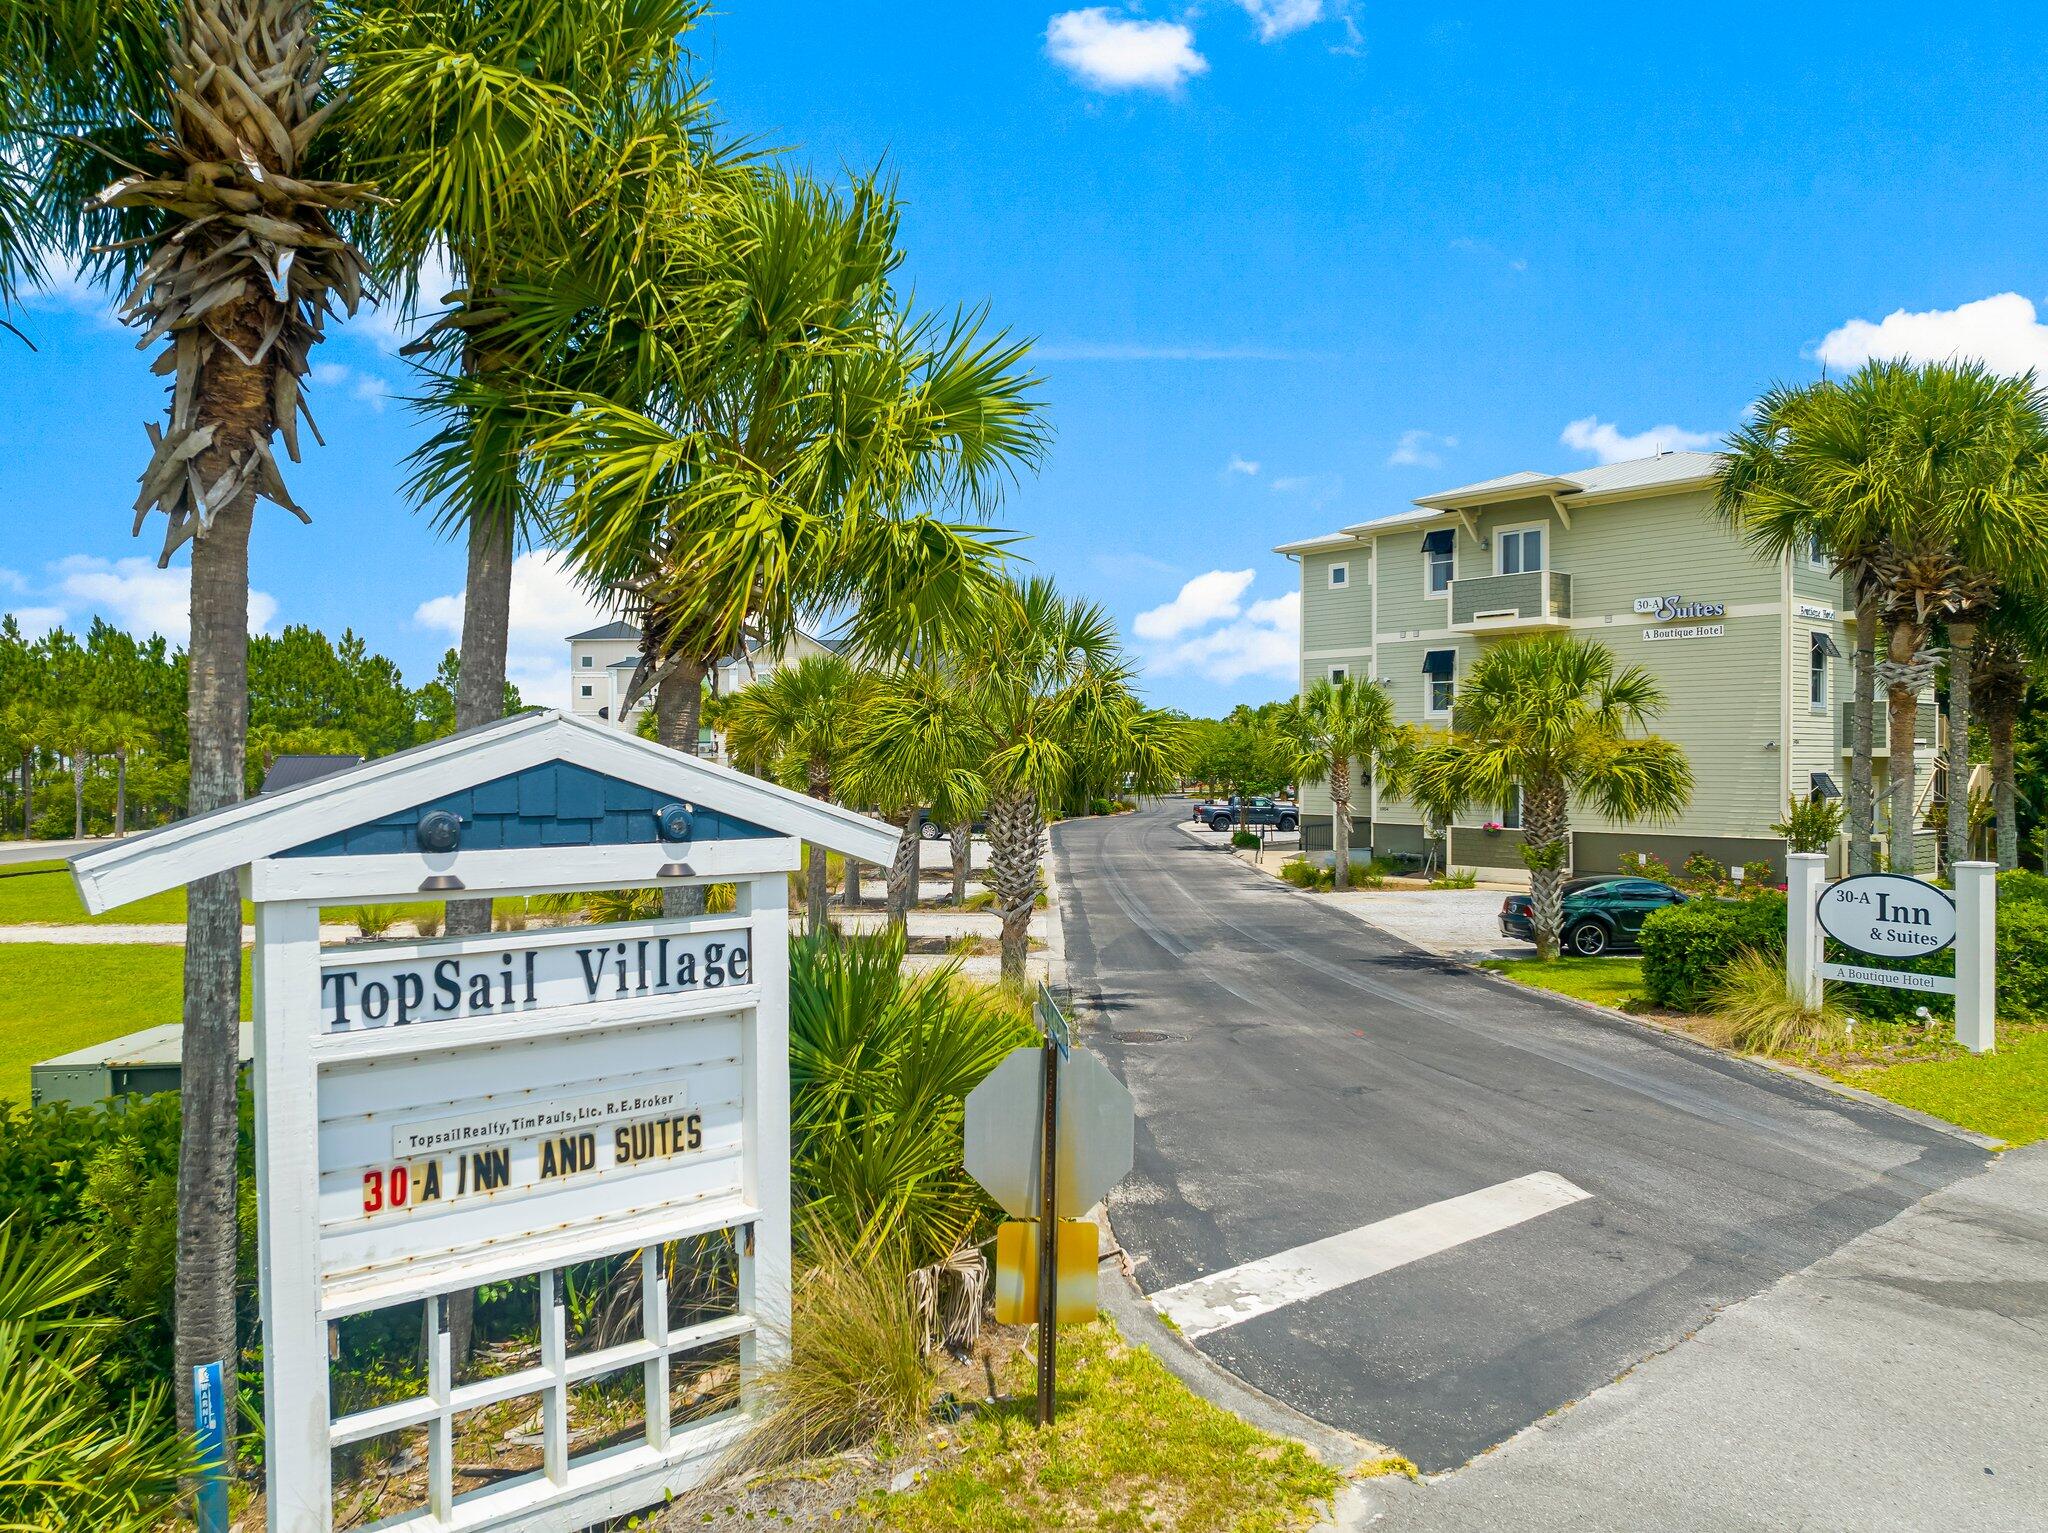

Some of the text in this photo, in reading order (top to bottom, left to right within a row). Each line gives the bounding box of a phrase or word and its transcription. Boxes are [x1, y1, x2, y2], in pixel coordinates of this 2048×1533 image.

[1637, 595, 1725, 621] 30-A Suites
[1644, 625, 1723, 639] A Boutique Hotel
[1836, 889, 1932, 926] 30-A Inn
[1870, 927, 1938, 946] & Suites
[322, 938, 749, 1027] TopSail Village
[1836, 967, 1935, 988] A Boutique Hotel
[363, 1159, 442, 1213] 30-A
[540, 1132, 597, 1180] AND
[614, 1113, 702, 1164] SUITES
